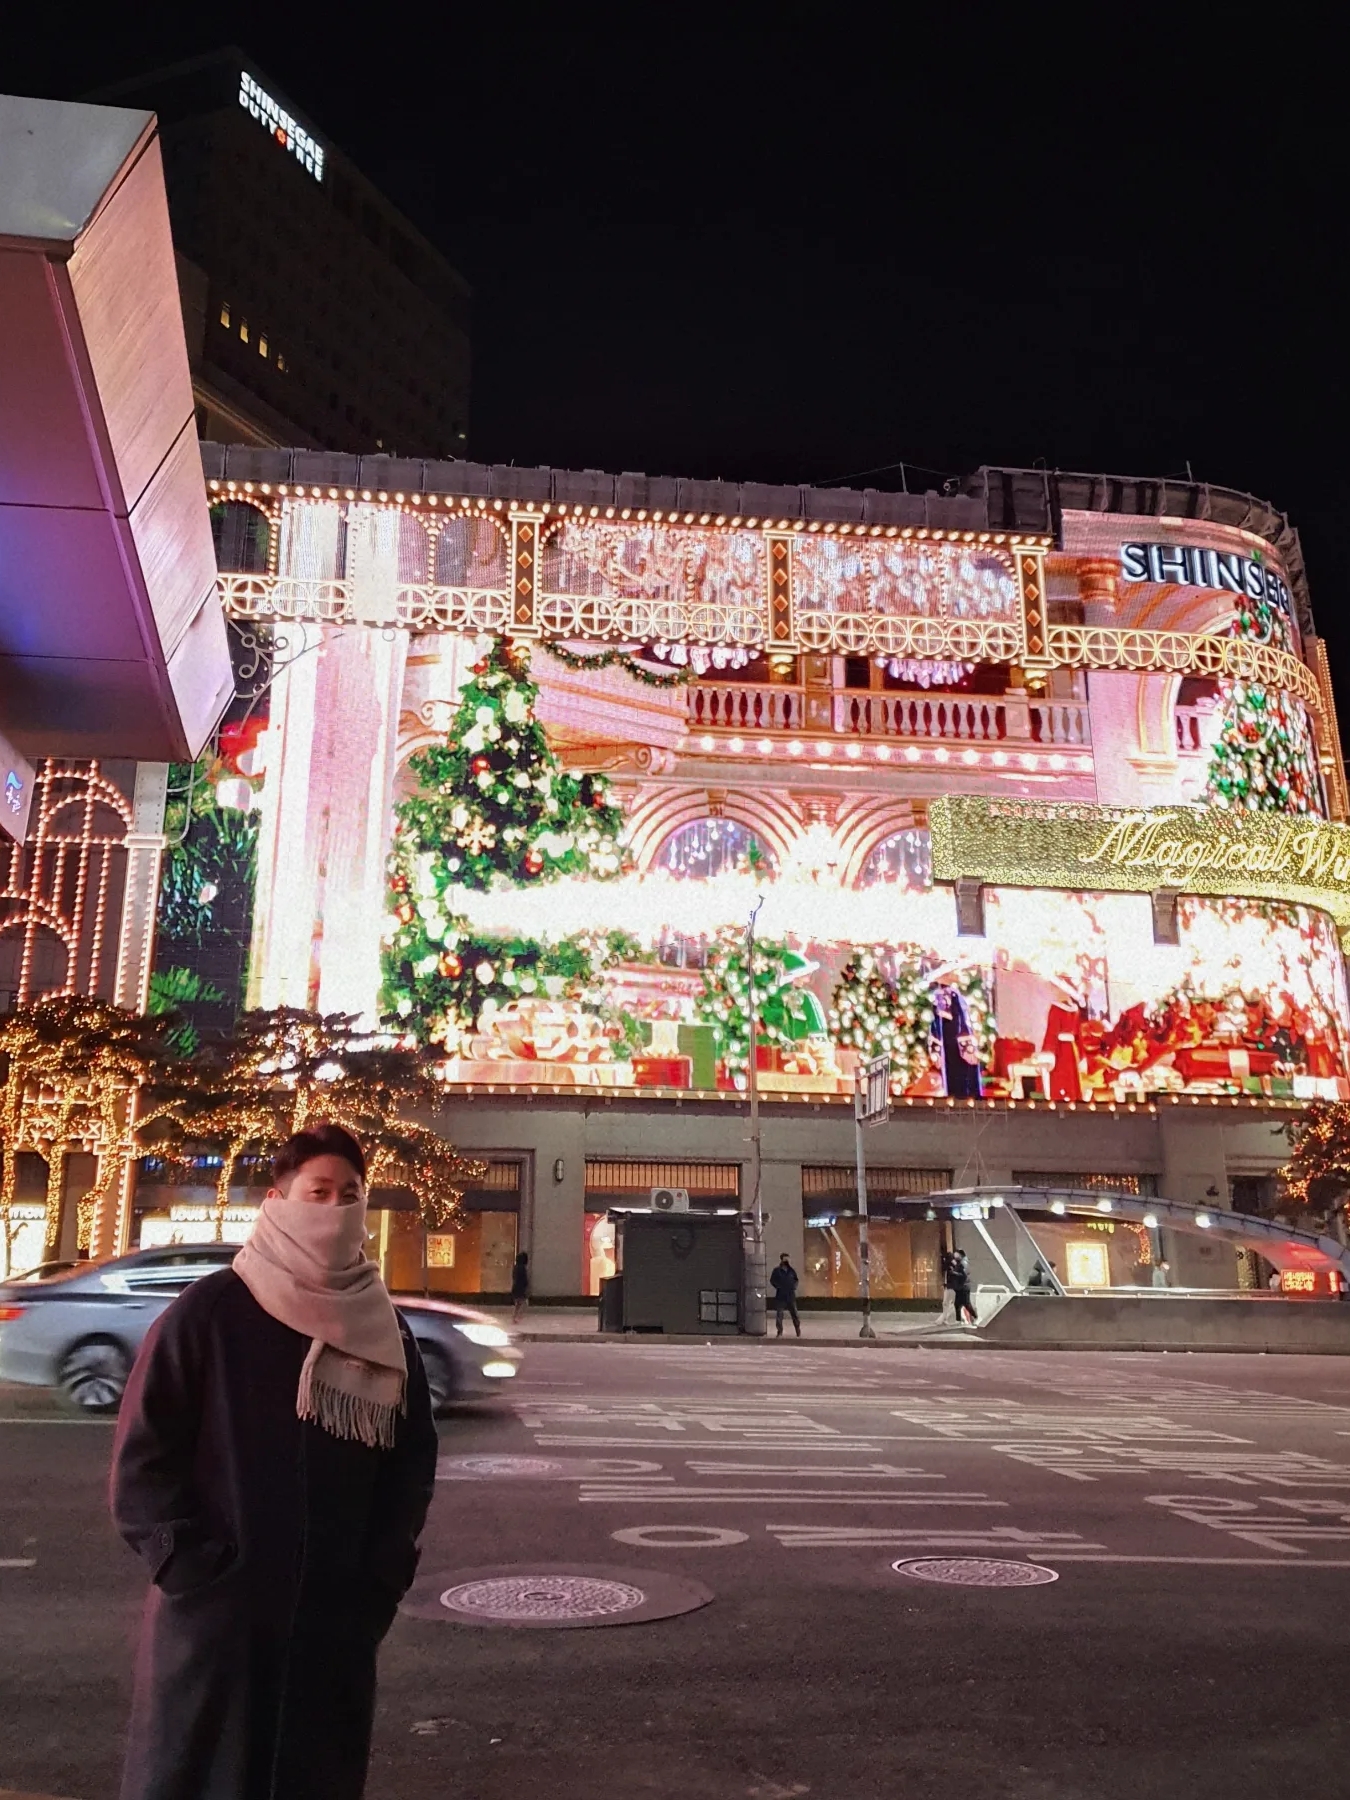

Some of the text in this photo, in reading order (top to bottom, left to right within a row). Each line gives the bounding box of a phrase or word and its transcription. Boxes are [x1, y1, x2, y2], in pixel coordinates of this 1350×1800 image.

[238, 89, 323, 183] DUTY FREE
[240, 70, 324, 166] SHINSEGAE
[1079, 812, 1292, 886] Magical
[170, 1205, 207, 1221] LOUIS
